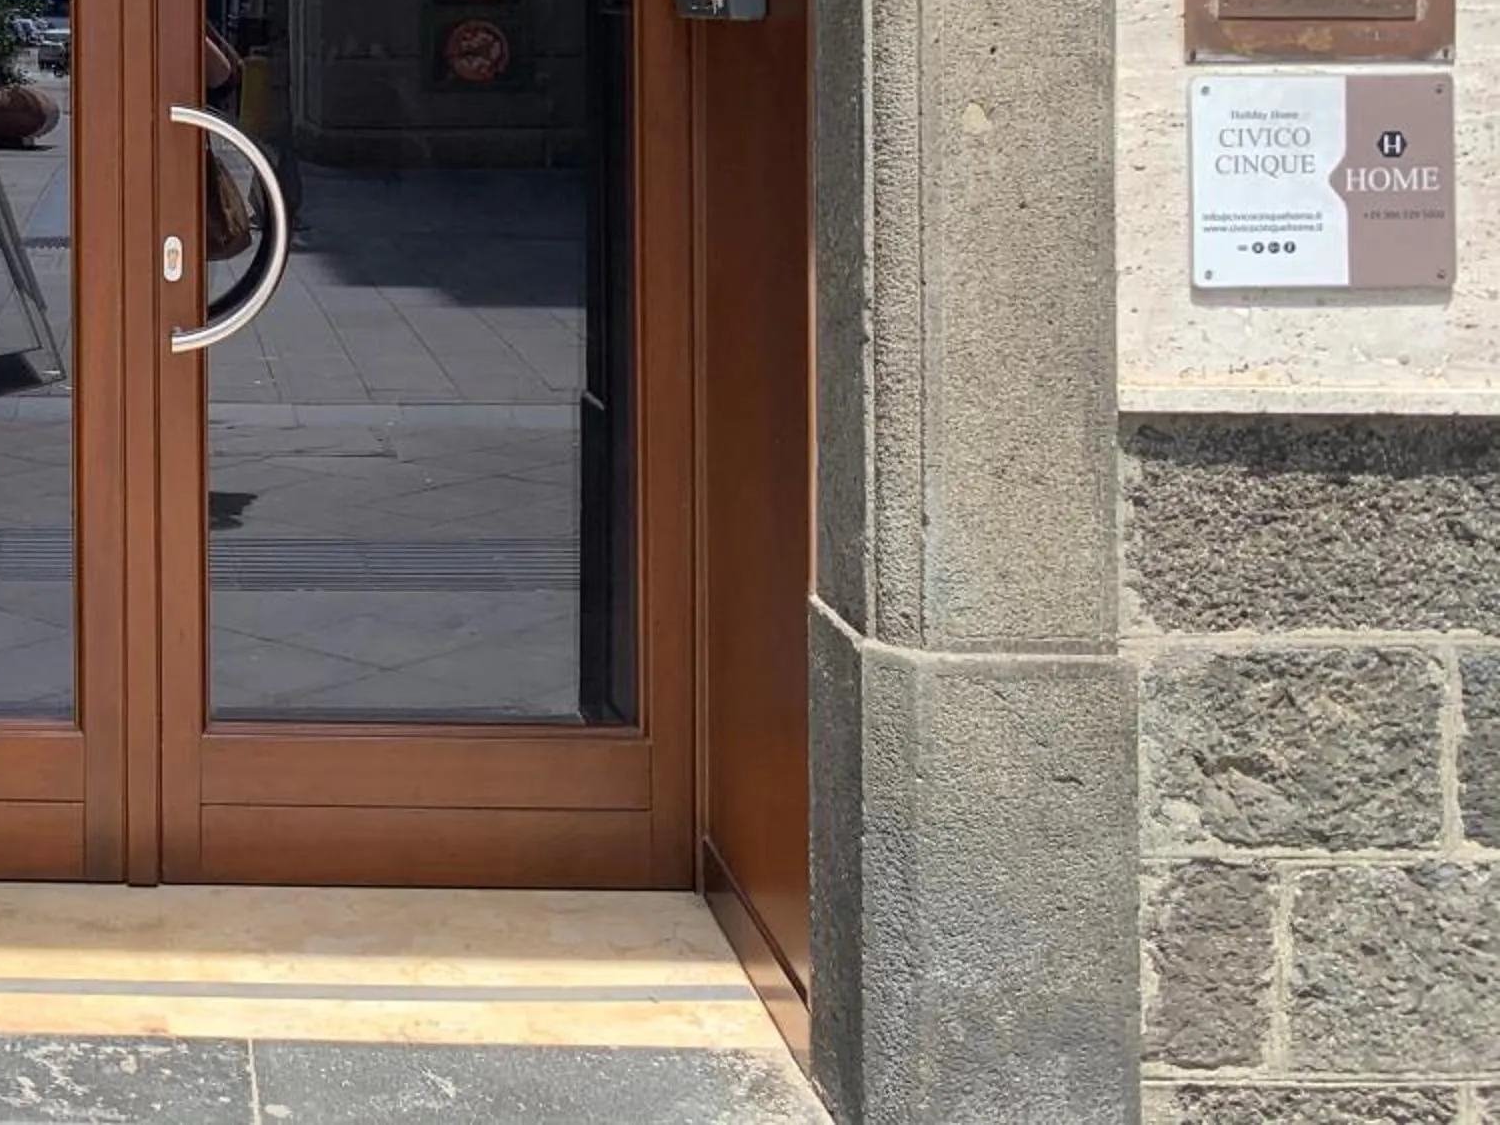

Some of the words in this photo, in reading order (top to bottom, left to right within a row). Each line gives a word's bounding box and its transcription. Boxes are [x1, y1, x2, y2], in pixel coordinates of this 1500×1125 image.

[1219, 127, 1311, 148] CIVICO
[1214, 154, 1316, 178] CINQUE
[1345, 167, 1441, 192] HOME
